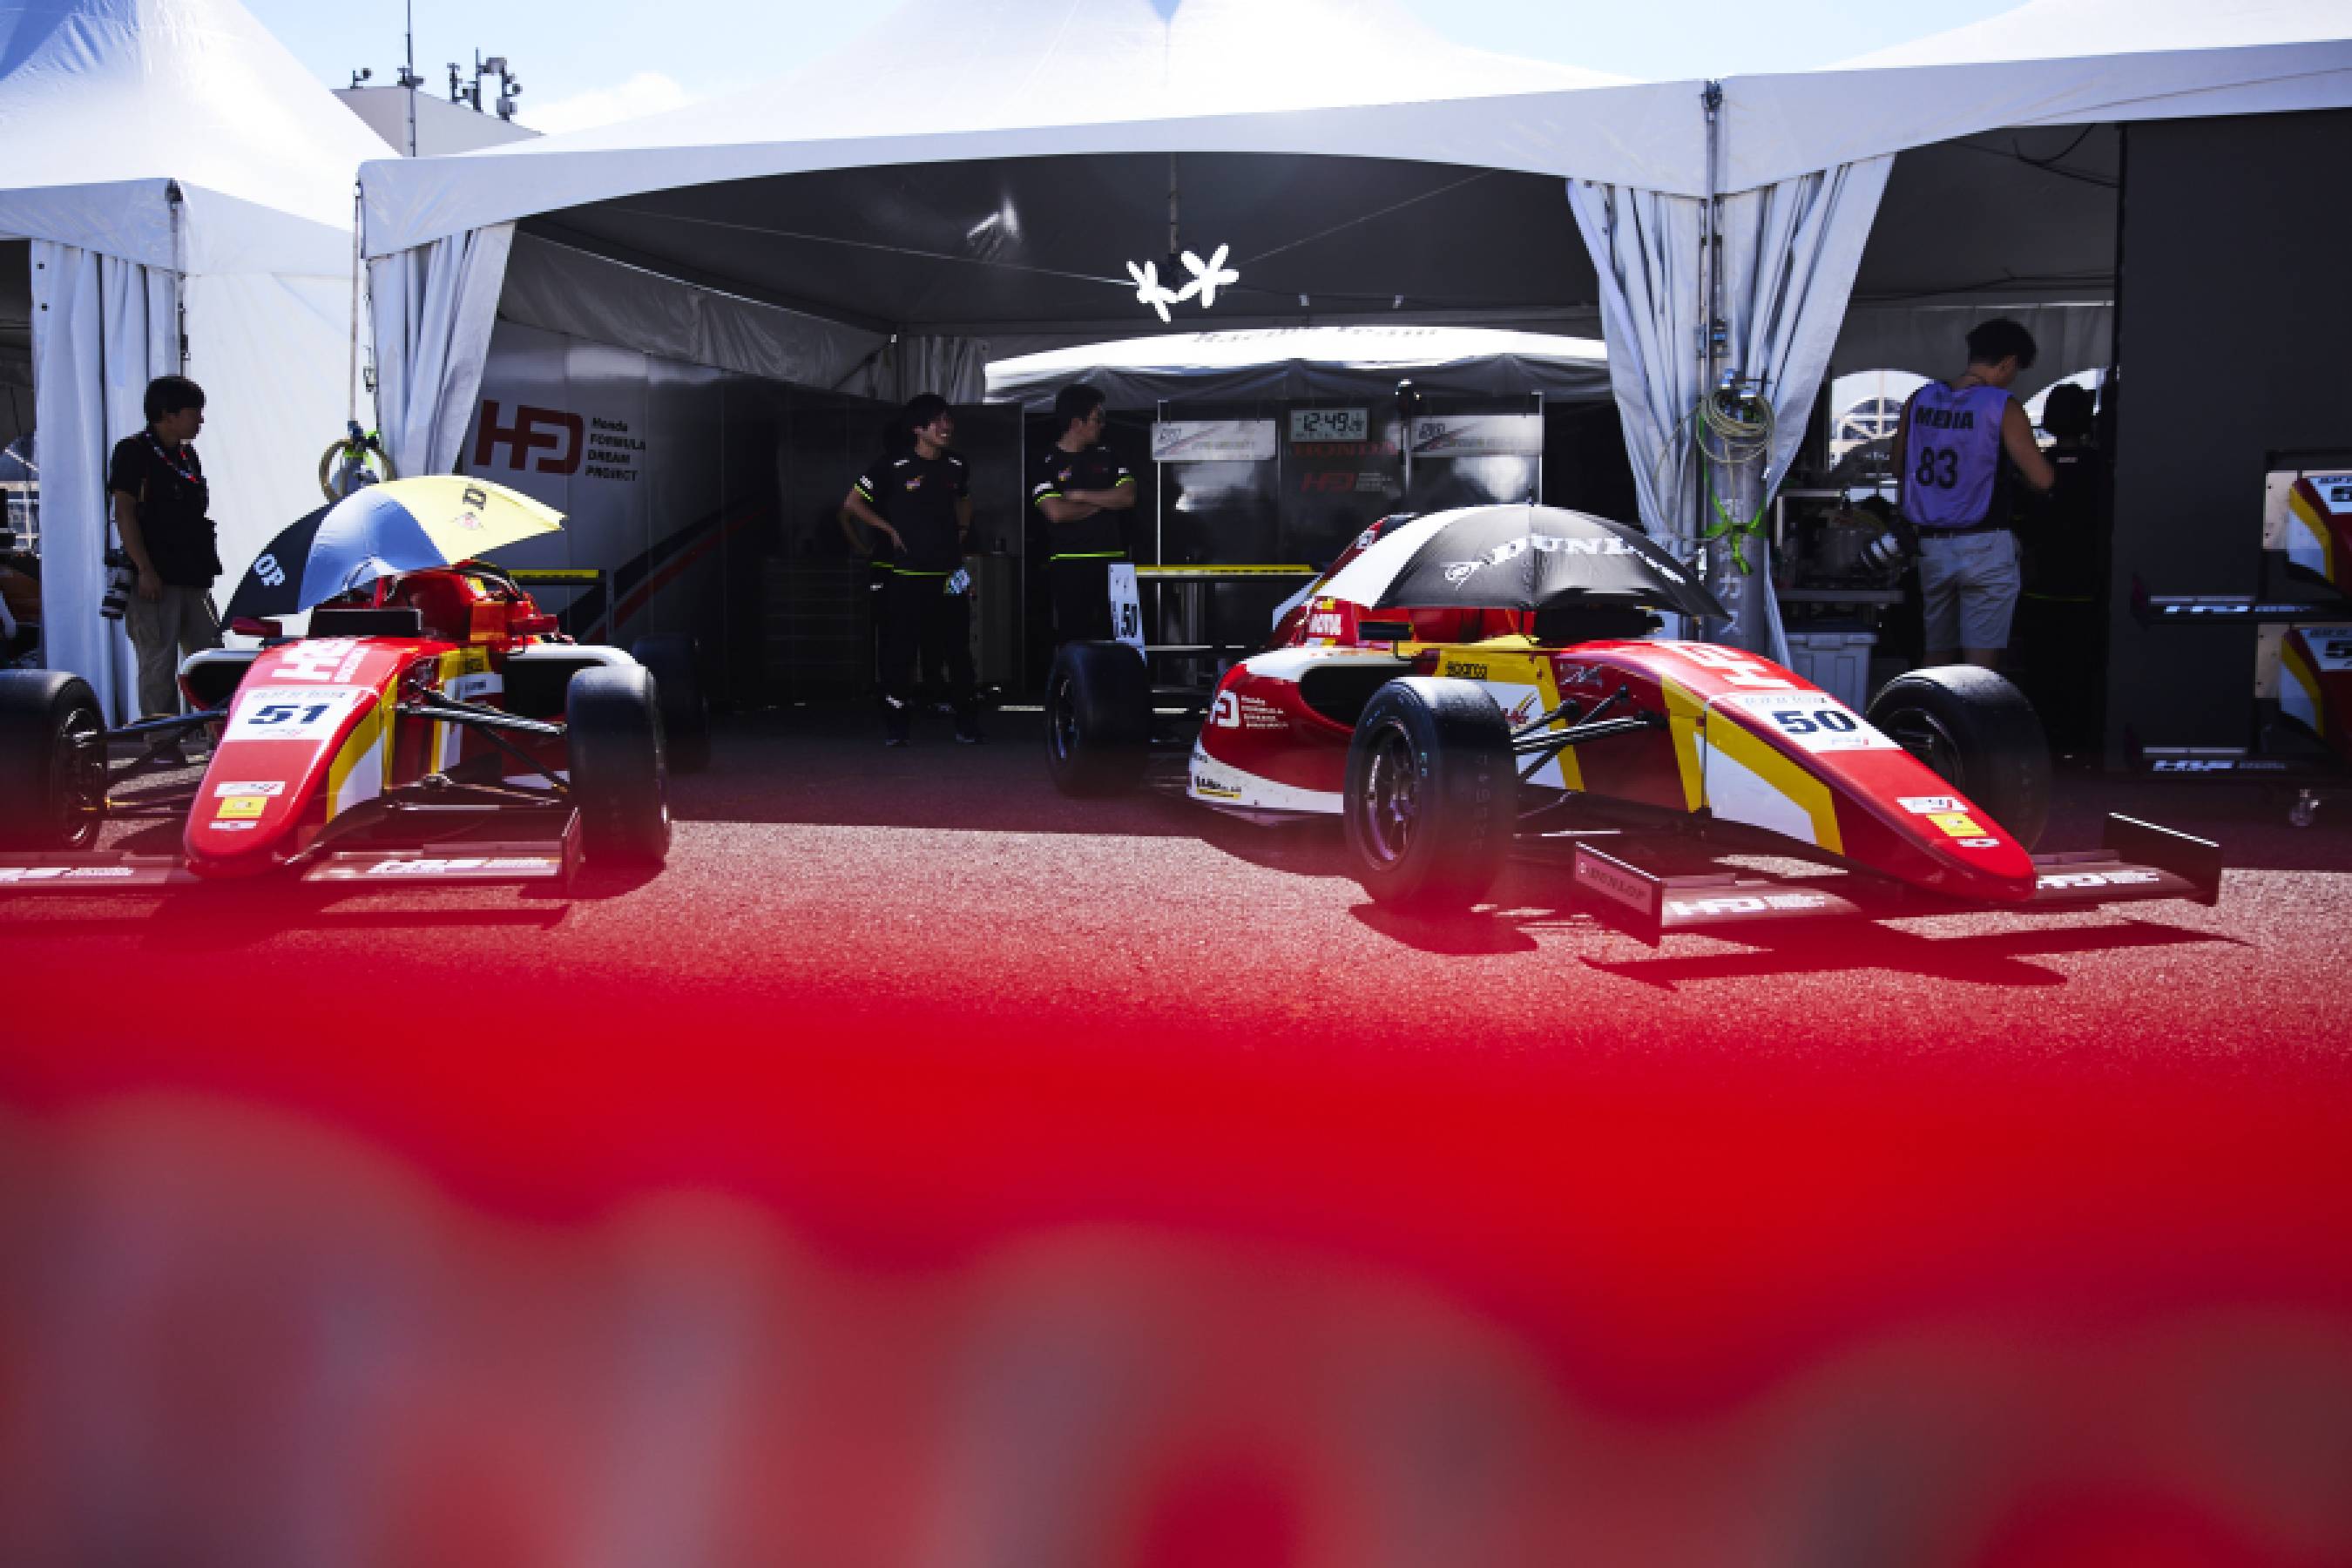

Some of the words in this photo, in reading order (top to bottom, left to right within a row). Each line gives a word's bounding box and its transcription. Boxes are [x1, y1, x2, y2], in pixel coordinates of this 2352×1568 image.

[1916, 446, 1958, 490] 83
[247, 704, 330, 725] 51
[1771, 710, 1858, 733] 50
